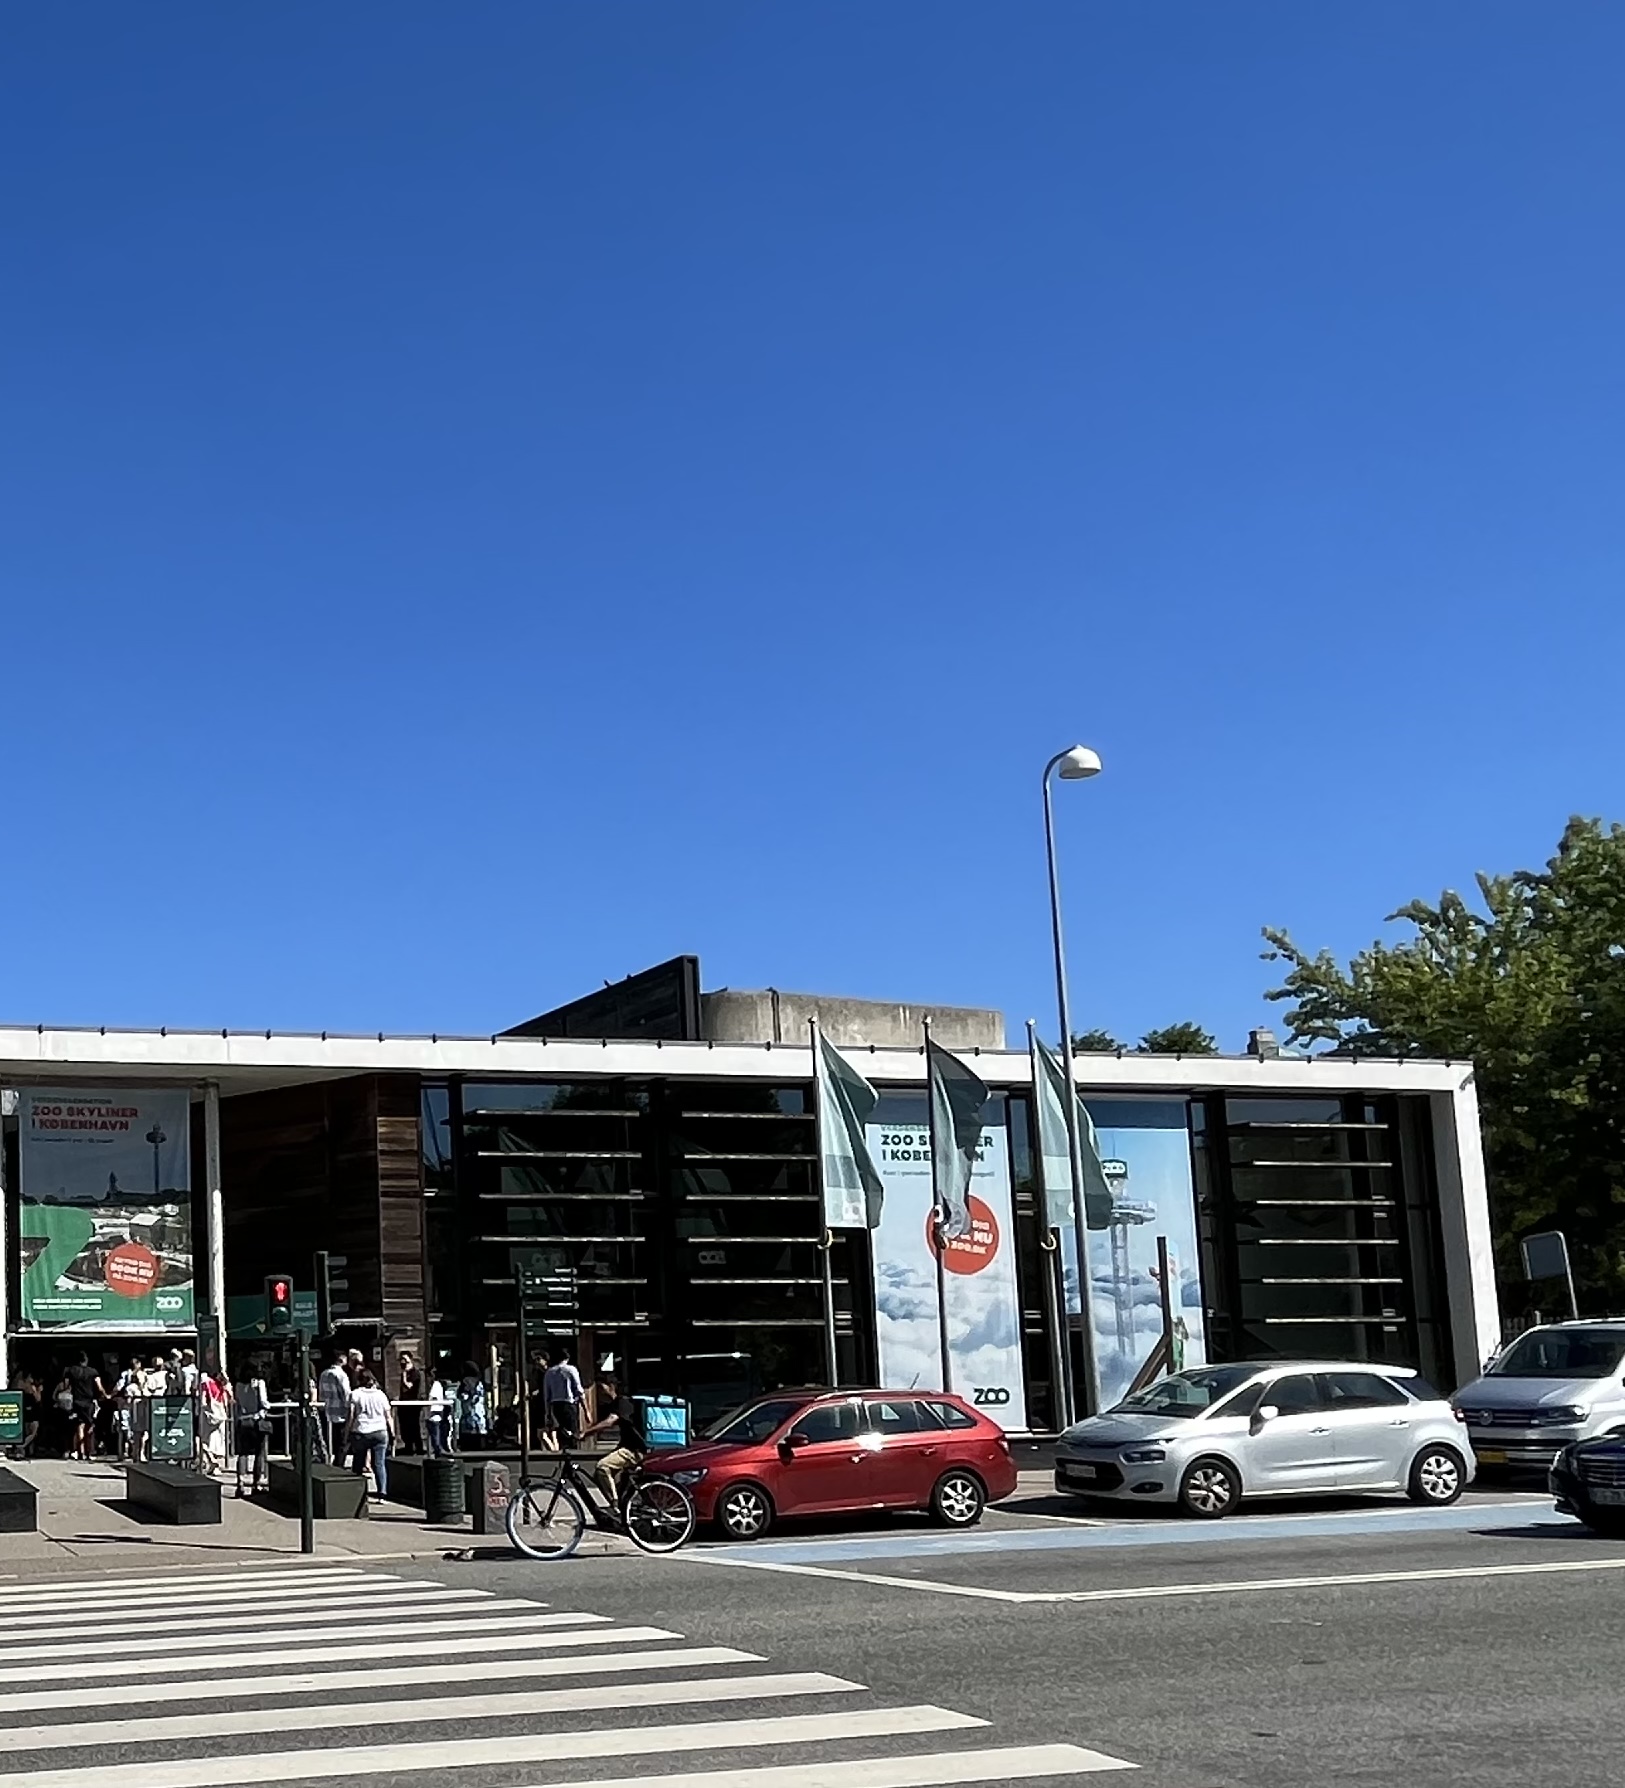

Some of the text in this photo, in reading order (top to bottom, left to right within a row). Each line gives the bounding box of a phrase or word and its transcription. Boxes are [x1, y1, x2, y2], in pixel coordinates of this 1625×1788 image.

[32, 1105, 138, 1118] ZOO SKYLINER
[881, 1134, 914, 1146] ZOO
[882, 1149, 887, 1161] I
[156, 1296, 184, 1309] ZOO
[973, 1387, 1010, 1405] ZOO
